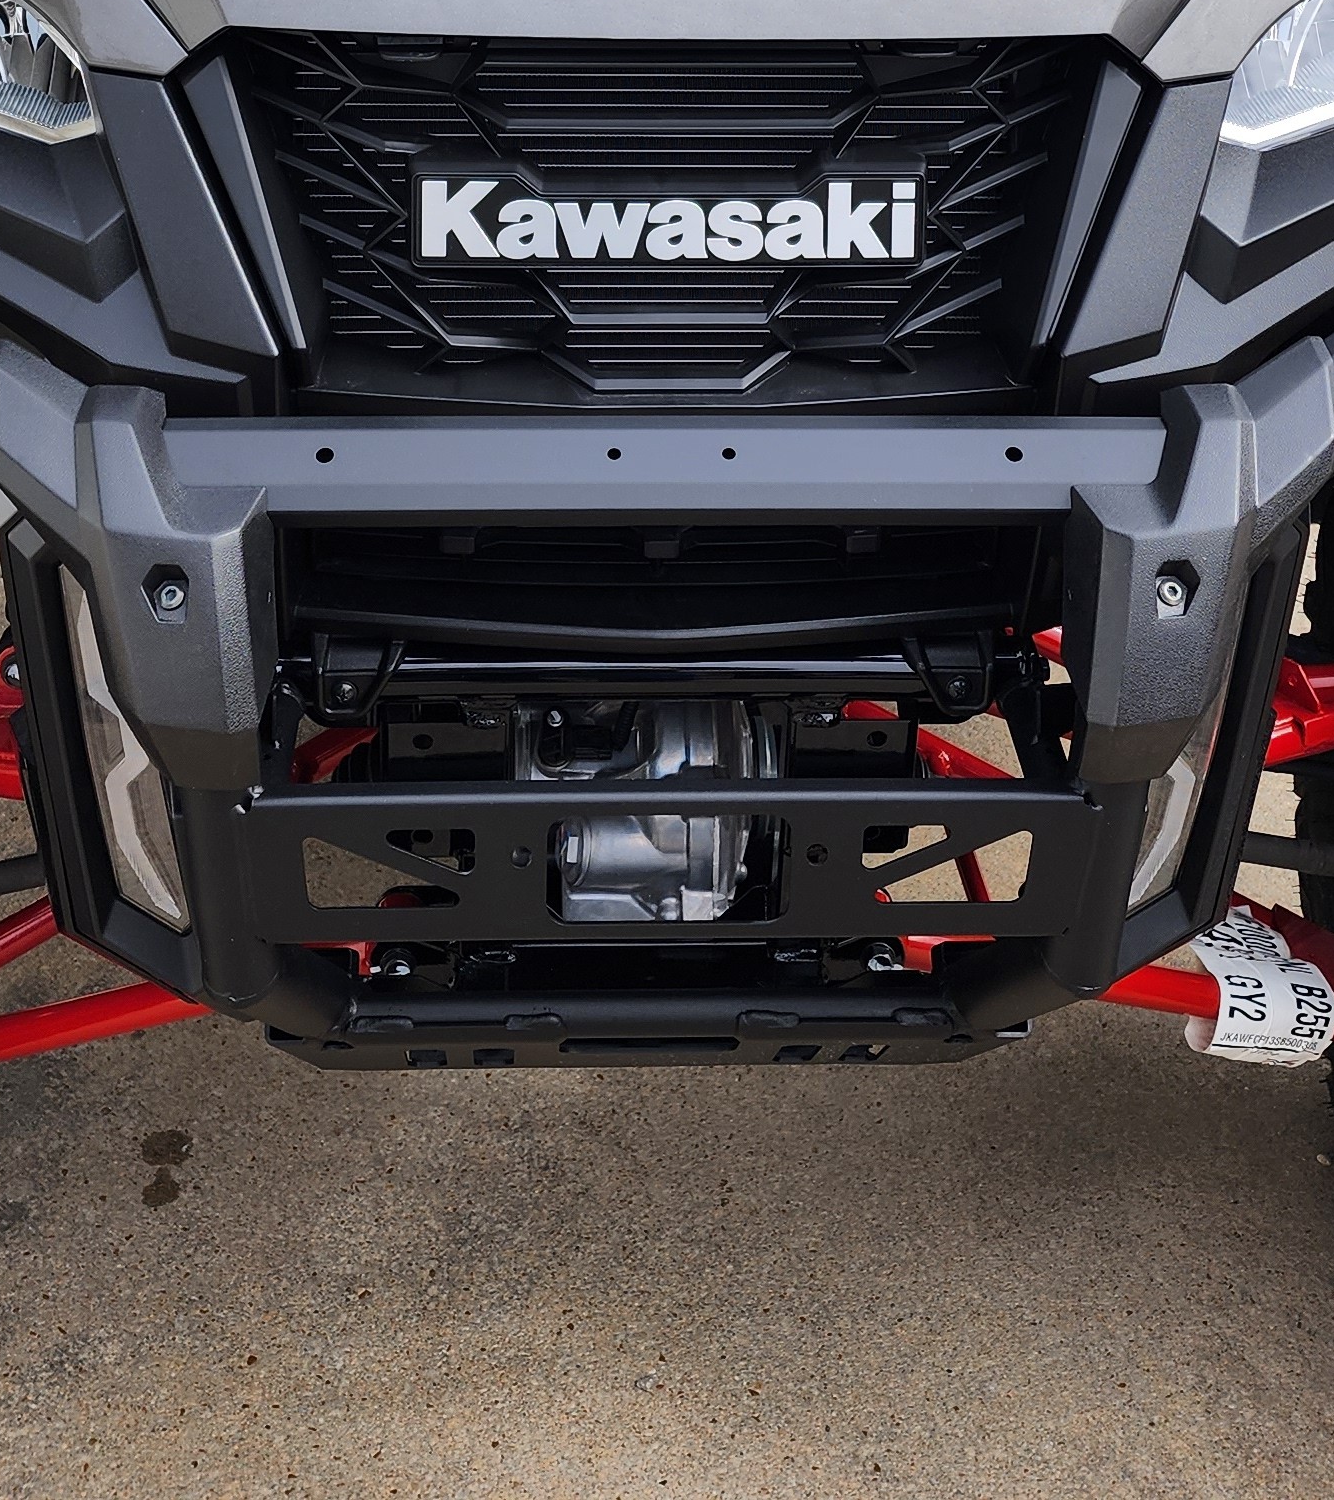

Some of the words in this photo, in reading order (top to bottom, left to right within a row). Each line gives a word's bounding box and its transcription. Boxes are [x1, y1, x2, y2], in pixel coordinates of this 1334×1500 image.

[421, 179, 916, 262] Kawasaki
[1224, 973, 1267, 1023] GY2
[1289, 982, 1334, 1041] B255
